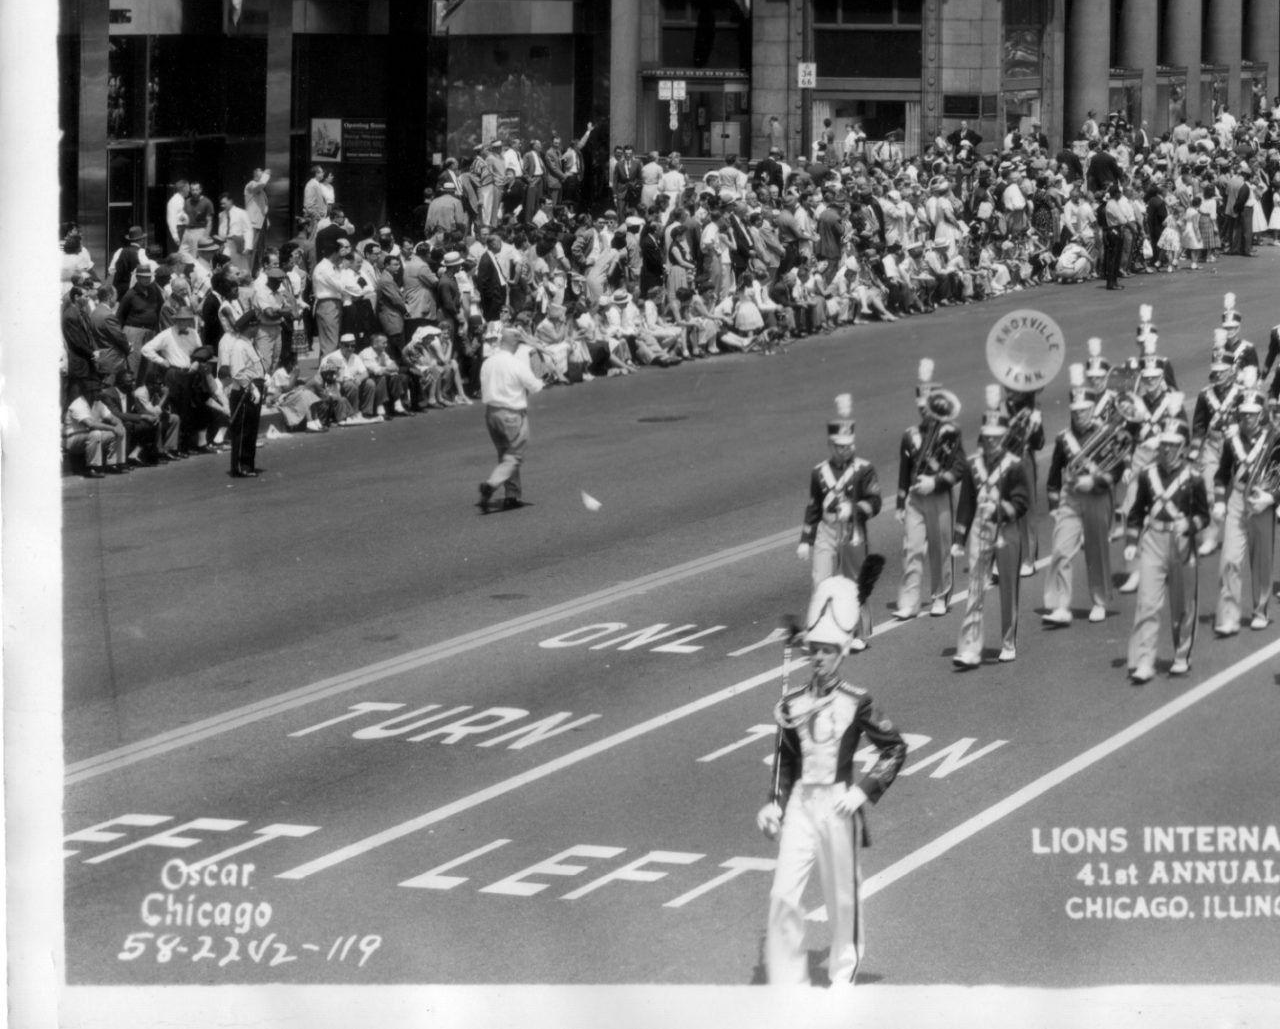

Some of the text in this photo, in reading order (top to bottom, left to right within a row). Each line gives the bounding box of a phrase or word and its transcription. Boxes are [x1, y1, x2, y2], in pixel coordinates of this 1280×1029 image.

[801, 69, 812, 78] 34
[801, 78, 812, 86] 66
[995, 317, 1060, 351] KNOXVILLE
[288, 702, 604, 750] TURN
[397, 839, 778, 908] LEFT
